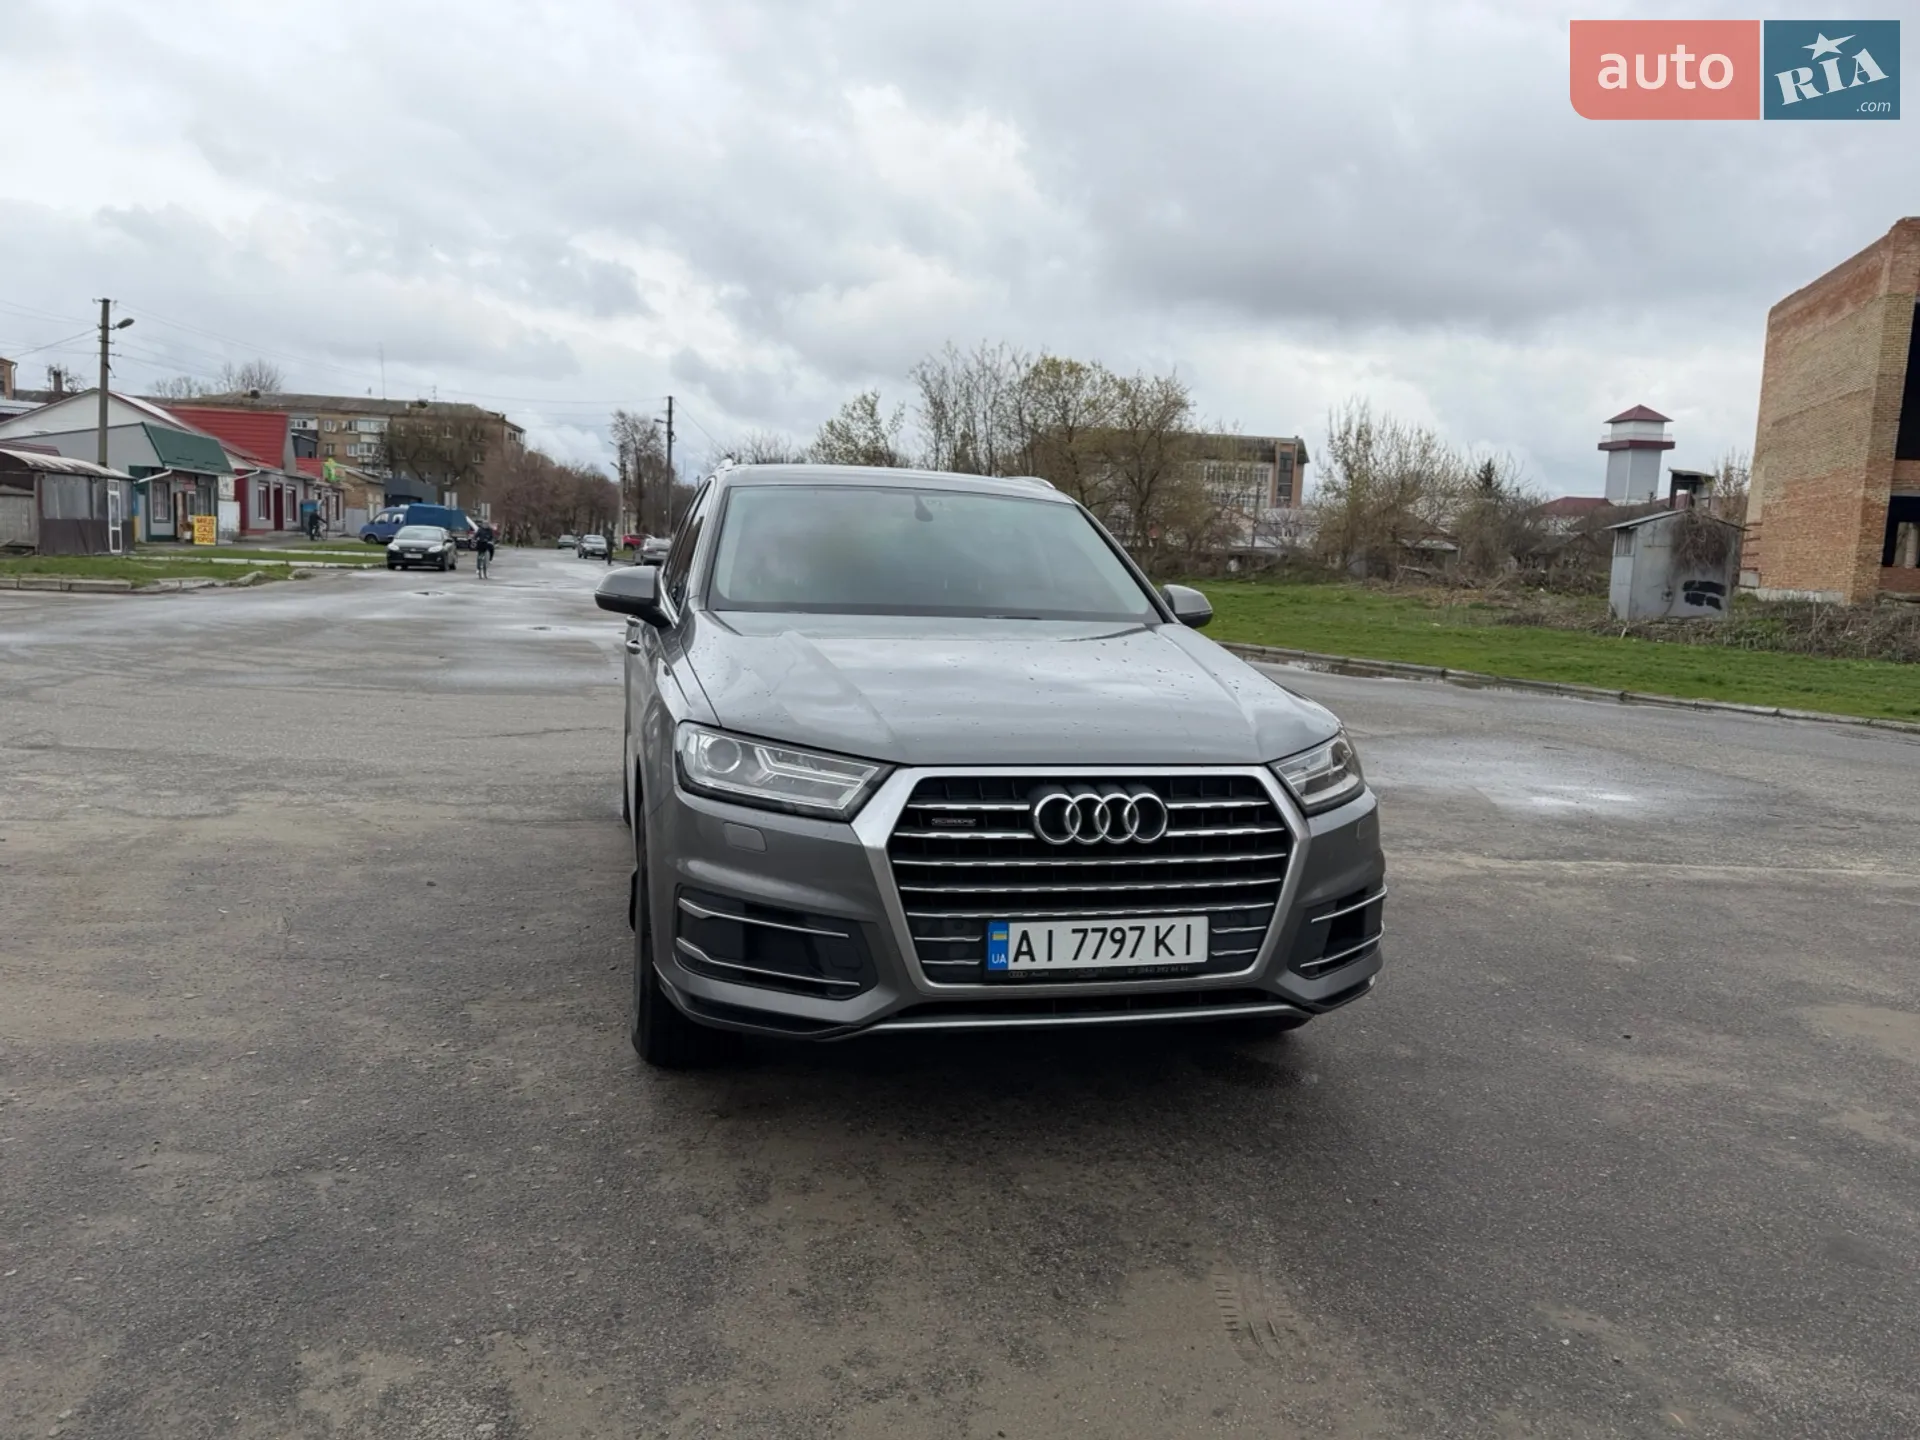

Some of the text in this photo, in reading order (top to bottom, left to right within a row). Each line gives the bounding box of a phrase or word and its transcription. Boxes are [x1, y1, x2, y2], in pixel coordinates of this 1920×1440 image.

[1012, 924, 1192, 962] AI 7797 KI
[991, 953, 1007, 964] UA
